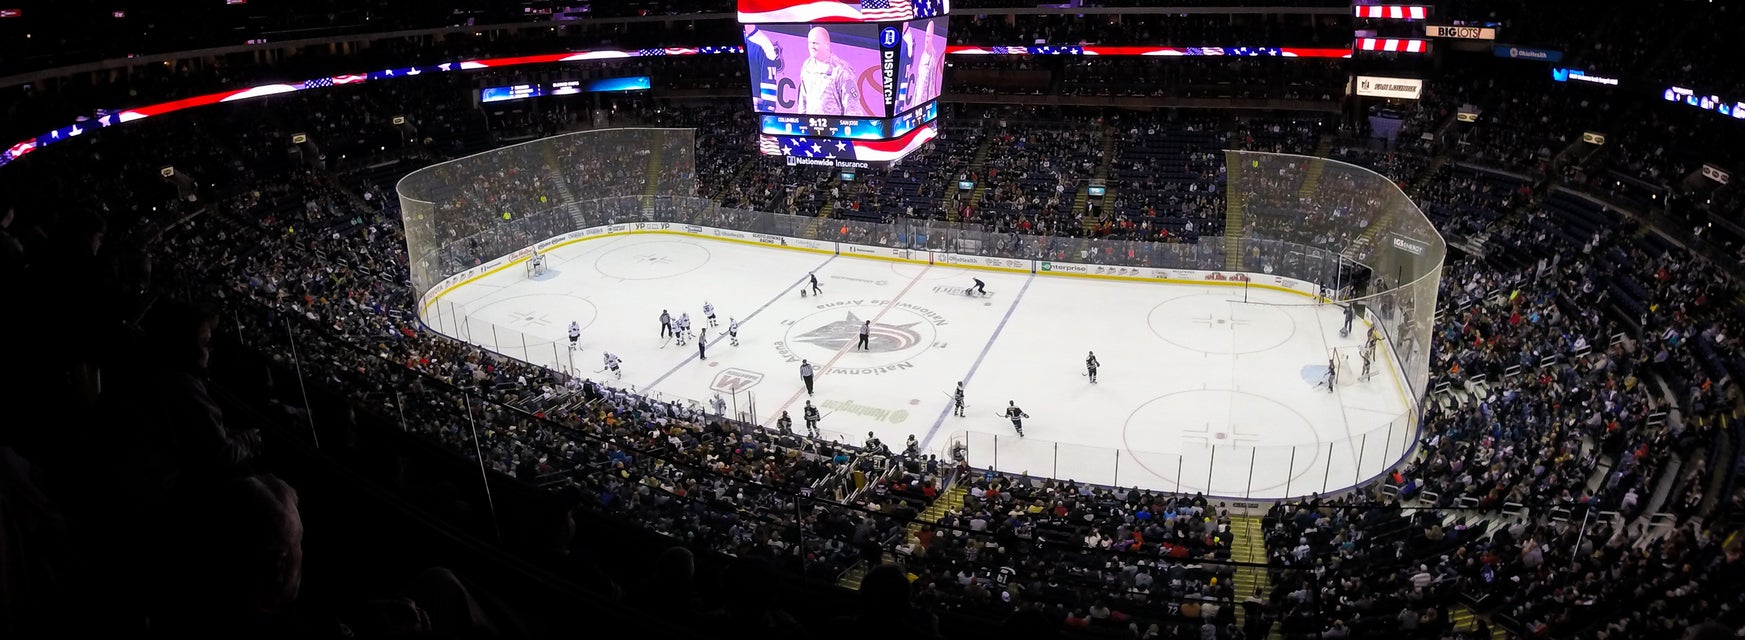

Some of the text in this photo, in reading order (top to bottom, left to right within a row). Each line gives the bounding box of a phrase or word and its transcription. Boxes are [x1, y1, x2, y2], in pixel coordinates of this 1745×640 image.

[1438, 28, 1457, 37] BIG
[884, 51, 894, 105] DISPATCH
[785, 122, 793, 133] 0
[809, 117, 827, 128] 9:12
[844, 126, 852, 136] 0
[796, 157, 868, 169] Nationwide Insurance
[816, 299, 949, 328] Nationwide Arena
[773, 341, 801, 364] Arena
[821, 399, 891, 422] Huntington
[996, 574, 1008, 584] 61
